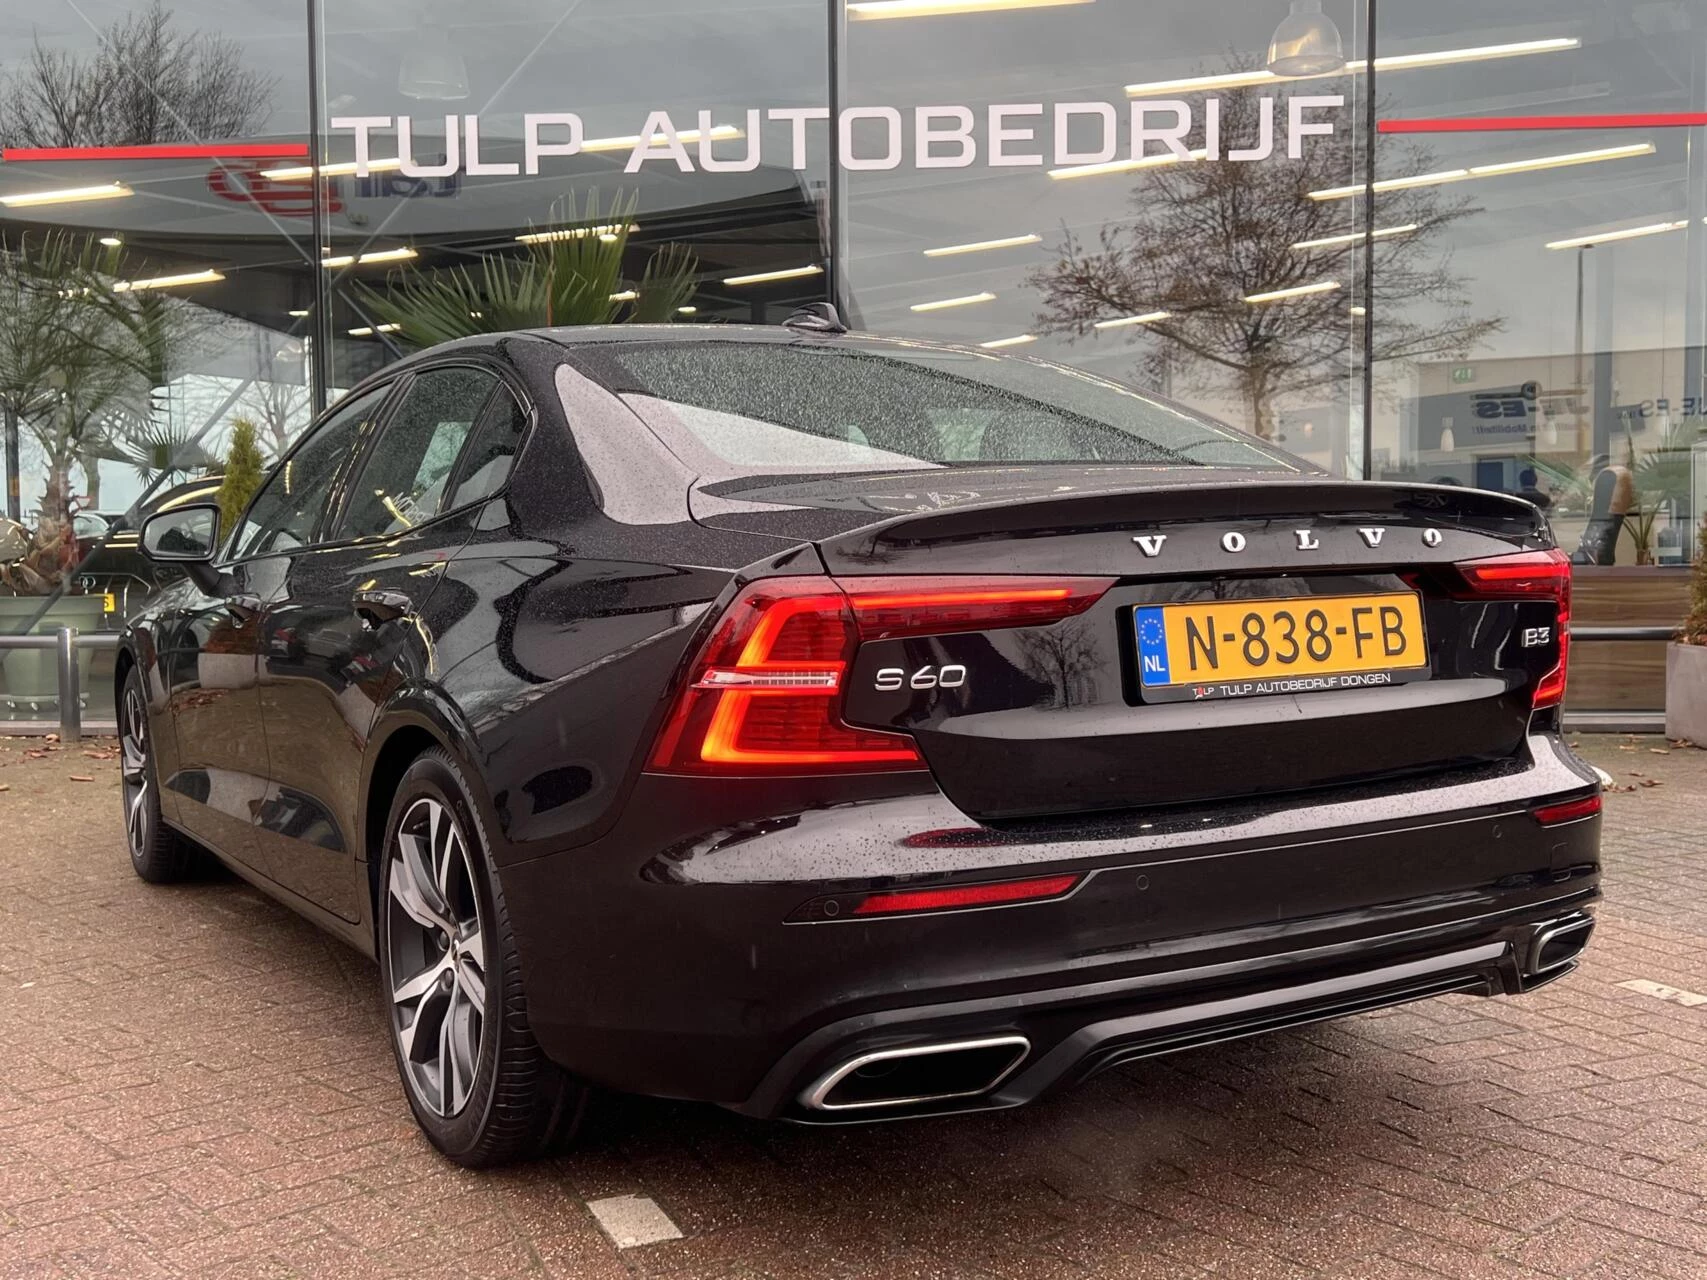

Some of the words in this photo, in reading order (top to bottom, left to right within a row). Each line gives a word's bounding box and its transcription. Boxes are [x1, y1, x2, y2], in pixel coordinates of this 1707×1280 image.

[331, 112, 584, 178] TULP
[624, 94, 1345, 173] AUTOBEDRIJF
[1132, 527, 1443, 557] VOLVO
[1185, 606, 1407, 671] N-838-FB
[1144, 655, 1166, 673] NL
[1220, 683, 1253, 697] TULP
[1256, 676, 1339, 694] AUTOBEDRIJF
[1340, 672, 1392, 687] DONGEN
